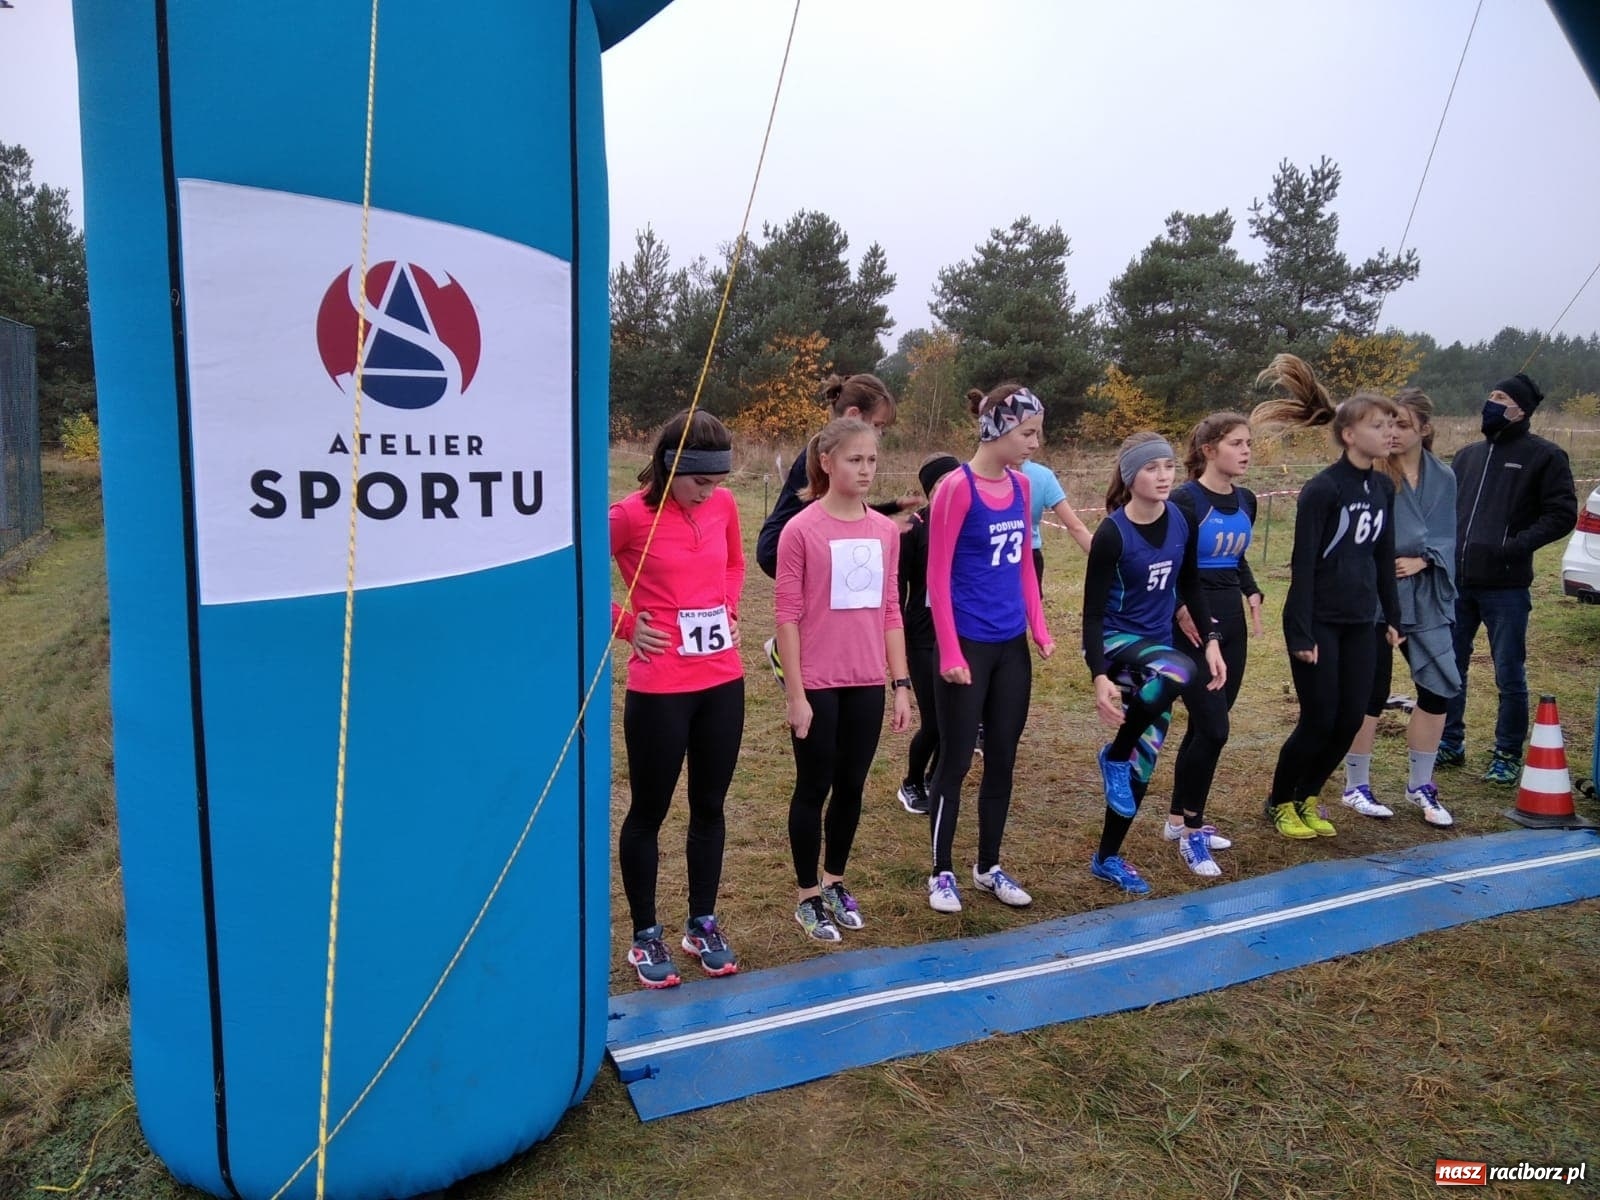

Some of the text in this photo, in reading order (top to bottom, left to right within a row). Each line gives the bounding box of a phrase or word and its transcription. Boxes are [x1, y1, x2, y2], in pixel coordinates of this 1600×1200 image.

[328, 433, 484, 456] ATELIER
[249, 469, 543, 521] SPORTU
[989, 519, 1025, 534] PODIUM
[1354, 508, 1384, 545] 61
[990, 530, 1024, 566] 73
[845, 544, 873, 592] 8
[1146, 566, 1172, 592] 57
[688, 624, 725, 652] 15
